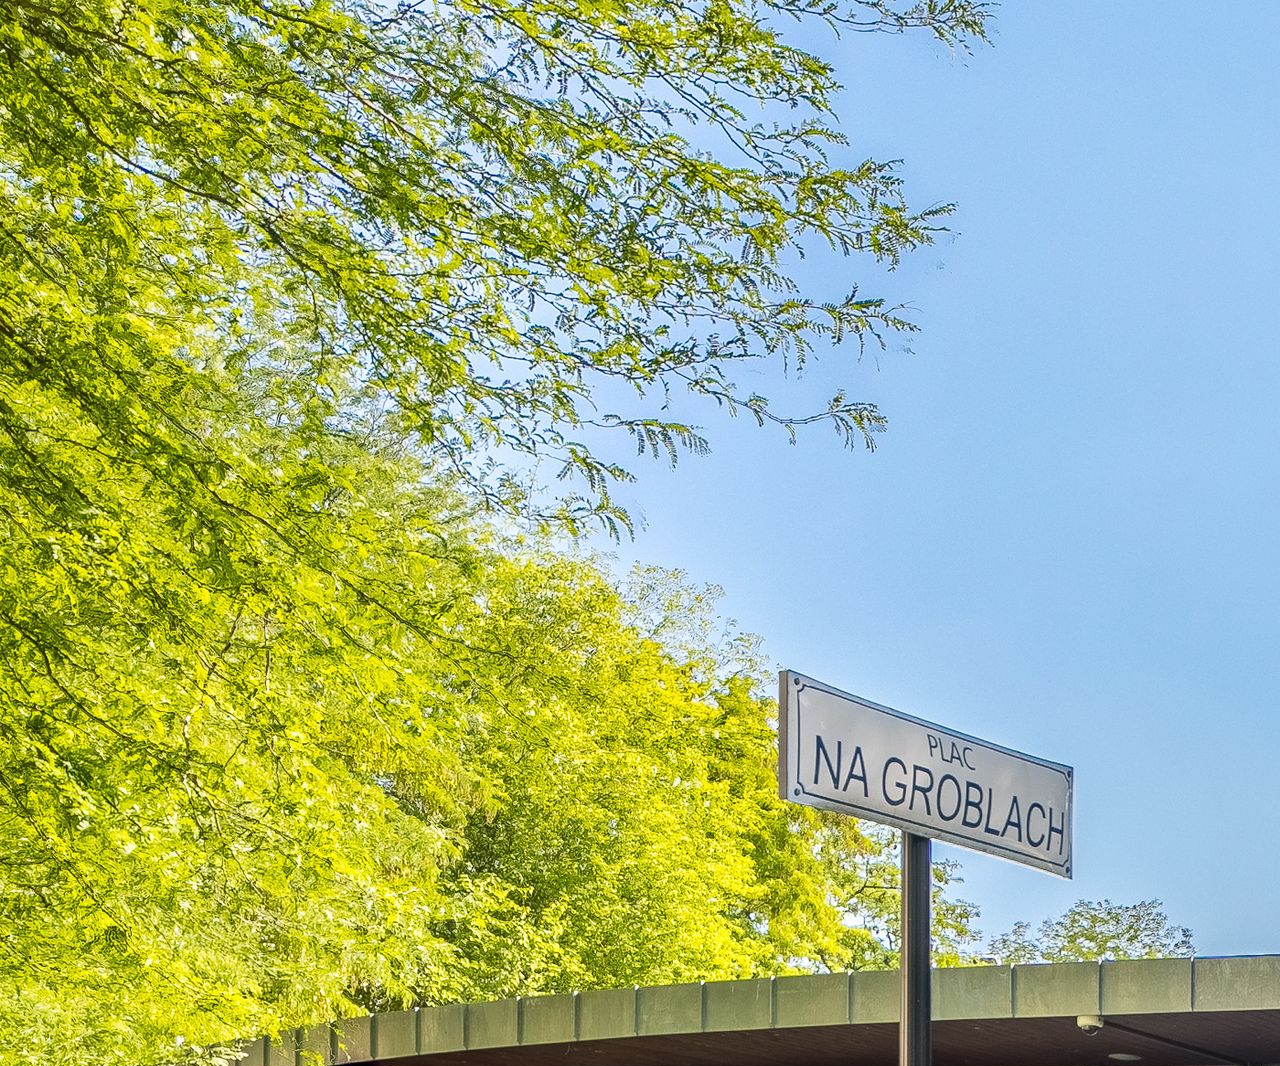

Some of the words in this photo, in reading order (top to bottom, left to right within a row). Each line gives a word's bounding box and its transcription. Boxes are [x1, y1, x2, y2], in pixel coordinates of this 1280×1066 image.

[926, 733, 976, 771] PLAC
[813, 734, 869, 798] NA
[882, 756, 1064, 855] GROBLACH
